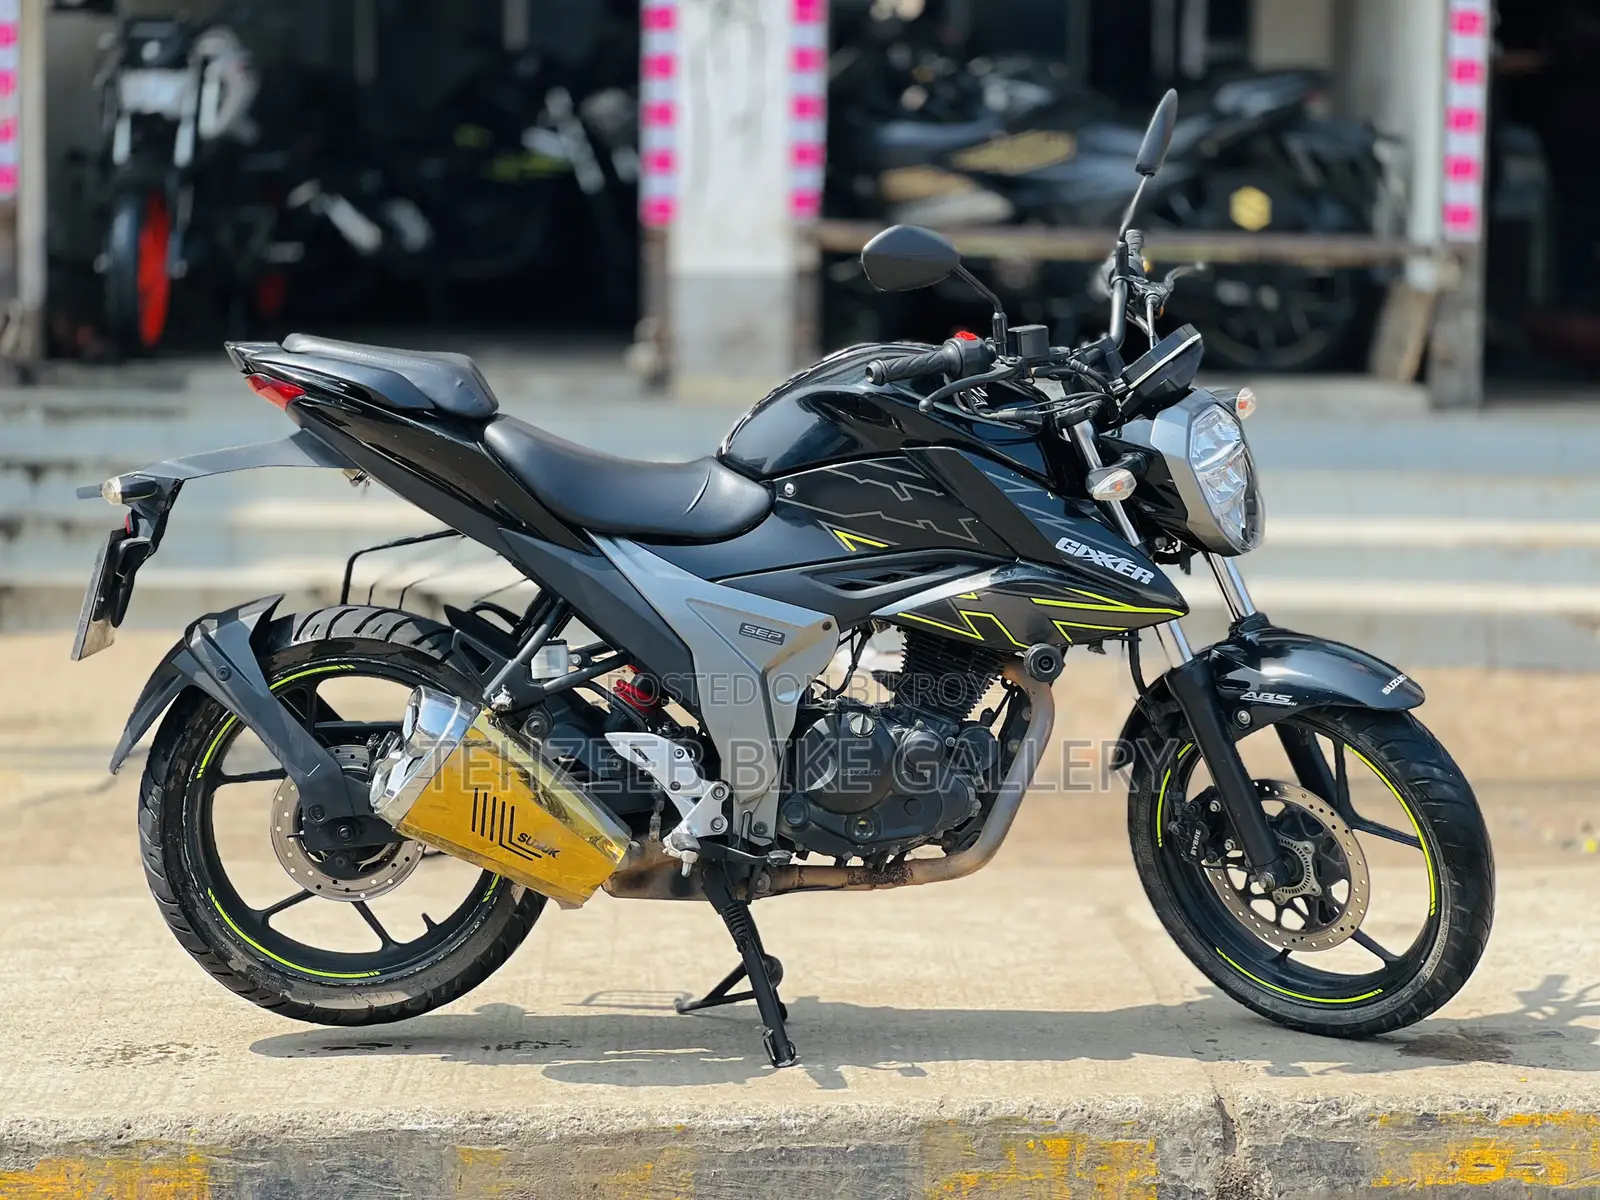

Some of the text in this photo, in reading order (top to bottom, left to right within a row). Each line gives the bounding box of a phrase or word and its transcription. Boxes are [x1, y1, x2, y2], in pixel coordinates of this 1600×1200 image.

[1055, 537, 1155, 585] GIXXER
[742, 625, 782, 639] SEP
[1240, 691, 1293, 705] ABS
[1190, 829, 1202, 857] BYBRE
